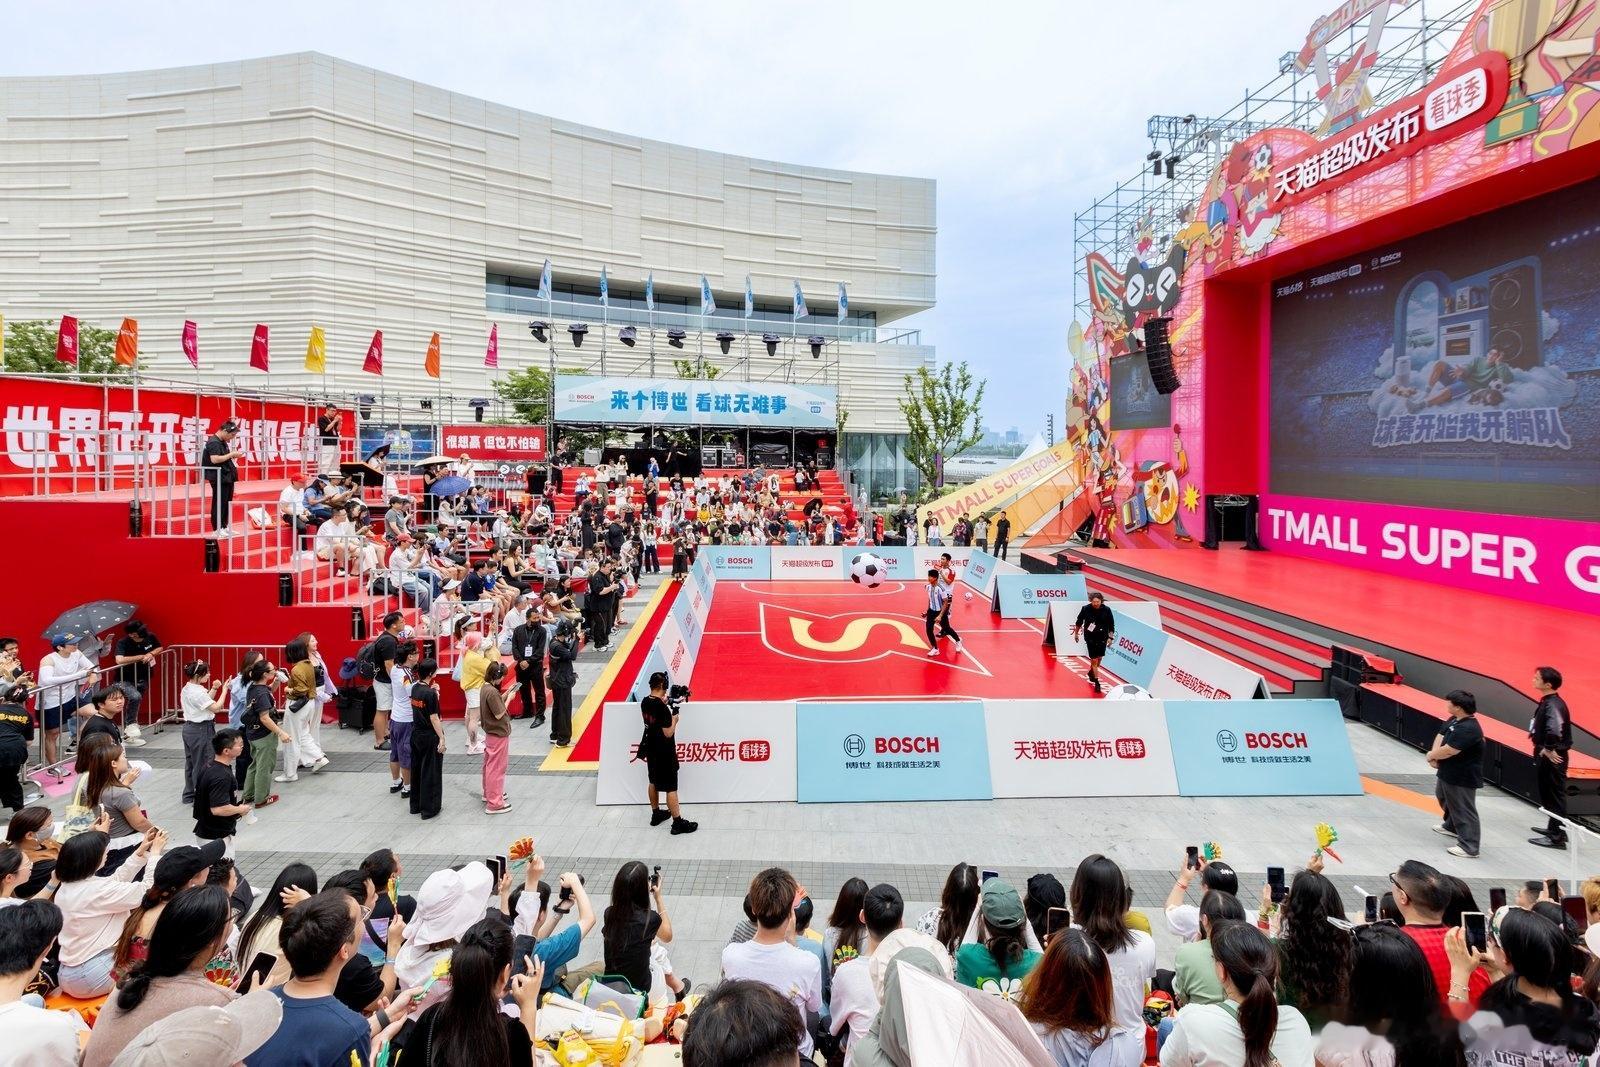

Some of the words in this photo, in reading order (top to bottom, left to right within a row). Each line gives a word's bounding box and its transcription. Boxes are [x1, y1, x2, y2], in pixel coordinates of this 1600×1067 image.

[1274, 105, 1420, 202] 天猫超级发布
[1431, 76, 1482, 124] 看球季
[610, 389, 688, 412] 来个博世
[695, 393, 787, 414] 看球无难事
[2, 405, 211, 468] 世界正开赛
[446, 435, 480, 449] 很想赢
[484, 435, 540, 450] 但也不怕输
[933, 487, 994, 526] TMALL
[993, 466, 1034, 495] SUPER
[1267, 508, 1368, 555] TMALL
[1381, 522, 1540, 584] SUPER
[727, 557, 753, 565] BOSCH
[781, 559, 821, 568] 天猫超级发布
[1036, 589, 1068, 598] BOSCH
[1118, 636, 1144, 657] BOSCH
[1166, 663, 1215, 699] 天猫超级发布
[874, 736, 940, 754] BOSCH
[1013, 739, 1113, 760] 天猫超级发布
[1118, 741, 1144, 757] 看球季
[1245, 732, 1308, 749] BOSCH
[629, 742, 735, 763] 天超级发布
[741, 743, 769, 759] 看球季
[845, 761, 872, 770] 博世
